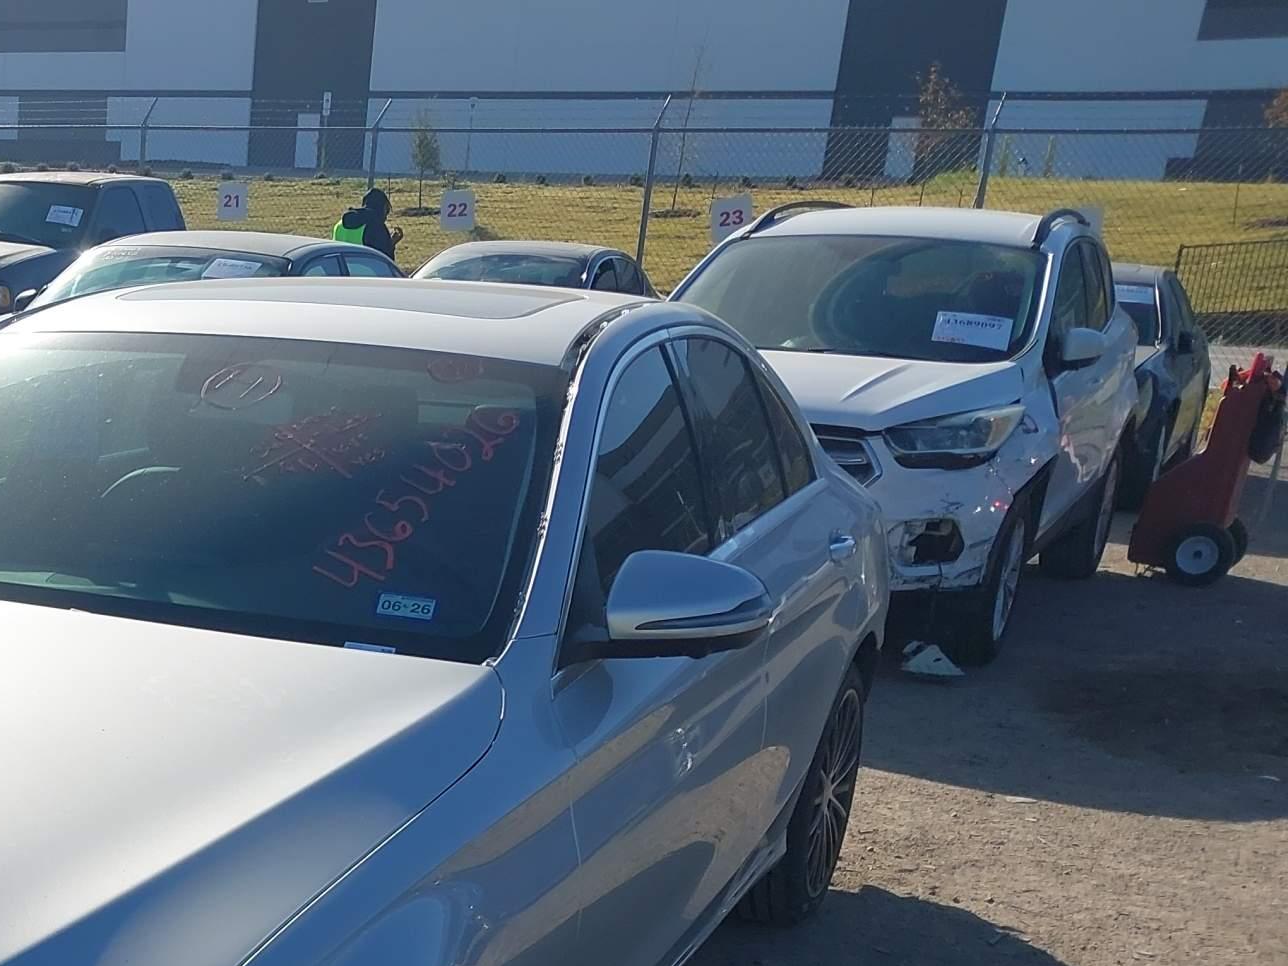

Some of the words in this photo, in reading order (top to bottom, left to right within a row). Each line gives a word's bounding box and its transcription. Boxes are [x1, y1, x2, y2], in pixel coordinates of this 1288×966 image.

[223, 195, 240, 208] 21
[447, 203, 467, 217] 22
[719, 209, 744, 227] 23
[313, 404, 520, 587] 43654026
